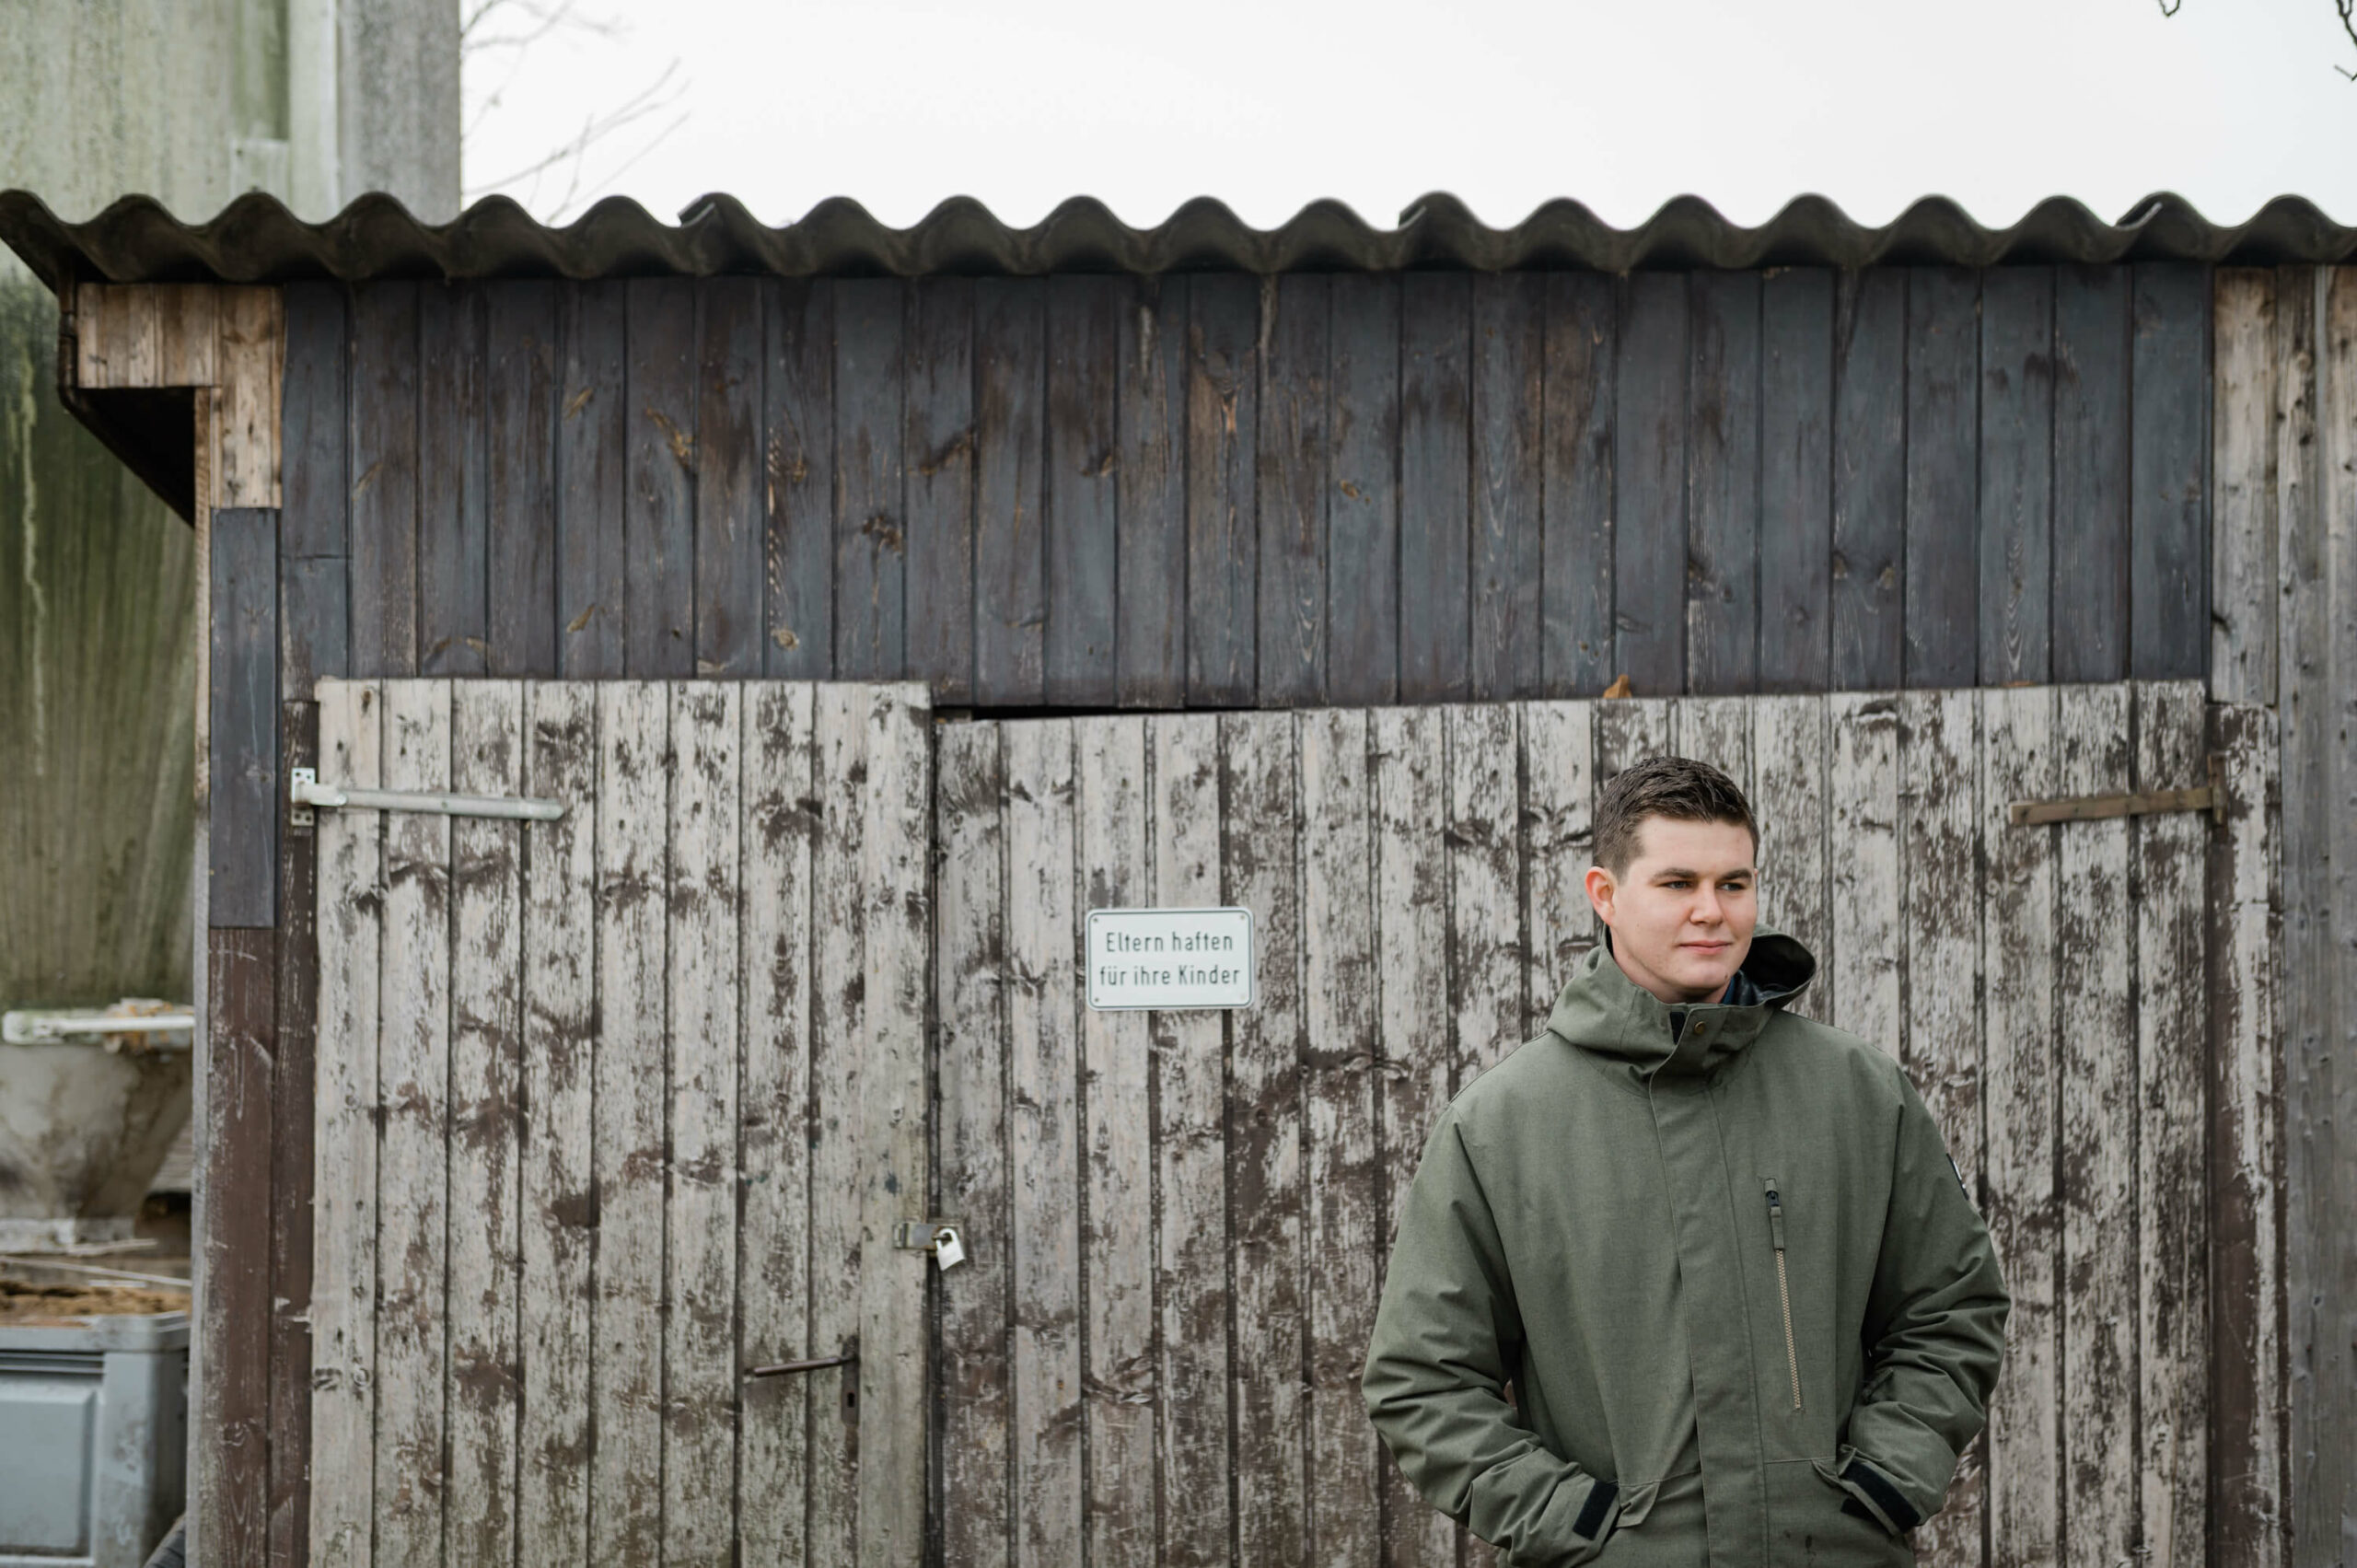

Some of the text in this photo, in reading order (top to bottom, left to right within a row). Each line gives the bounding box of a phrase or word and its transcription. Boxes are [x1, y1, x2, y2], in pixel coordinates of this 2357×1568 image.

[1106, 931, 1233, 952] Eltern haften
[1100, 964, 1240, 985] für ihre Kinder
